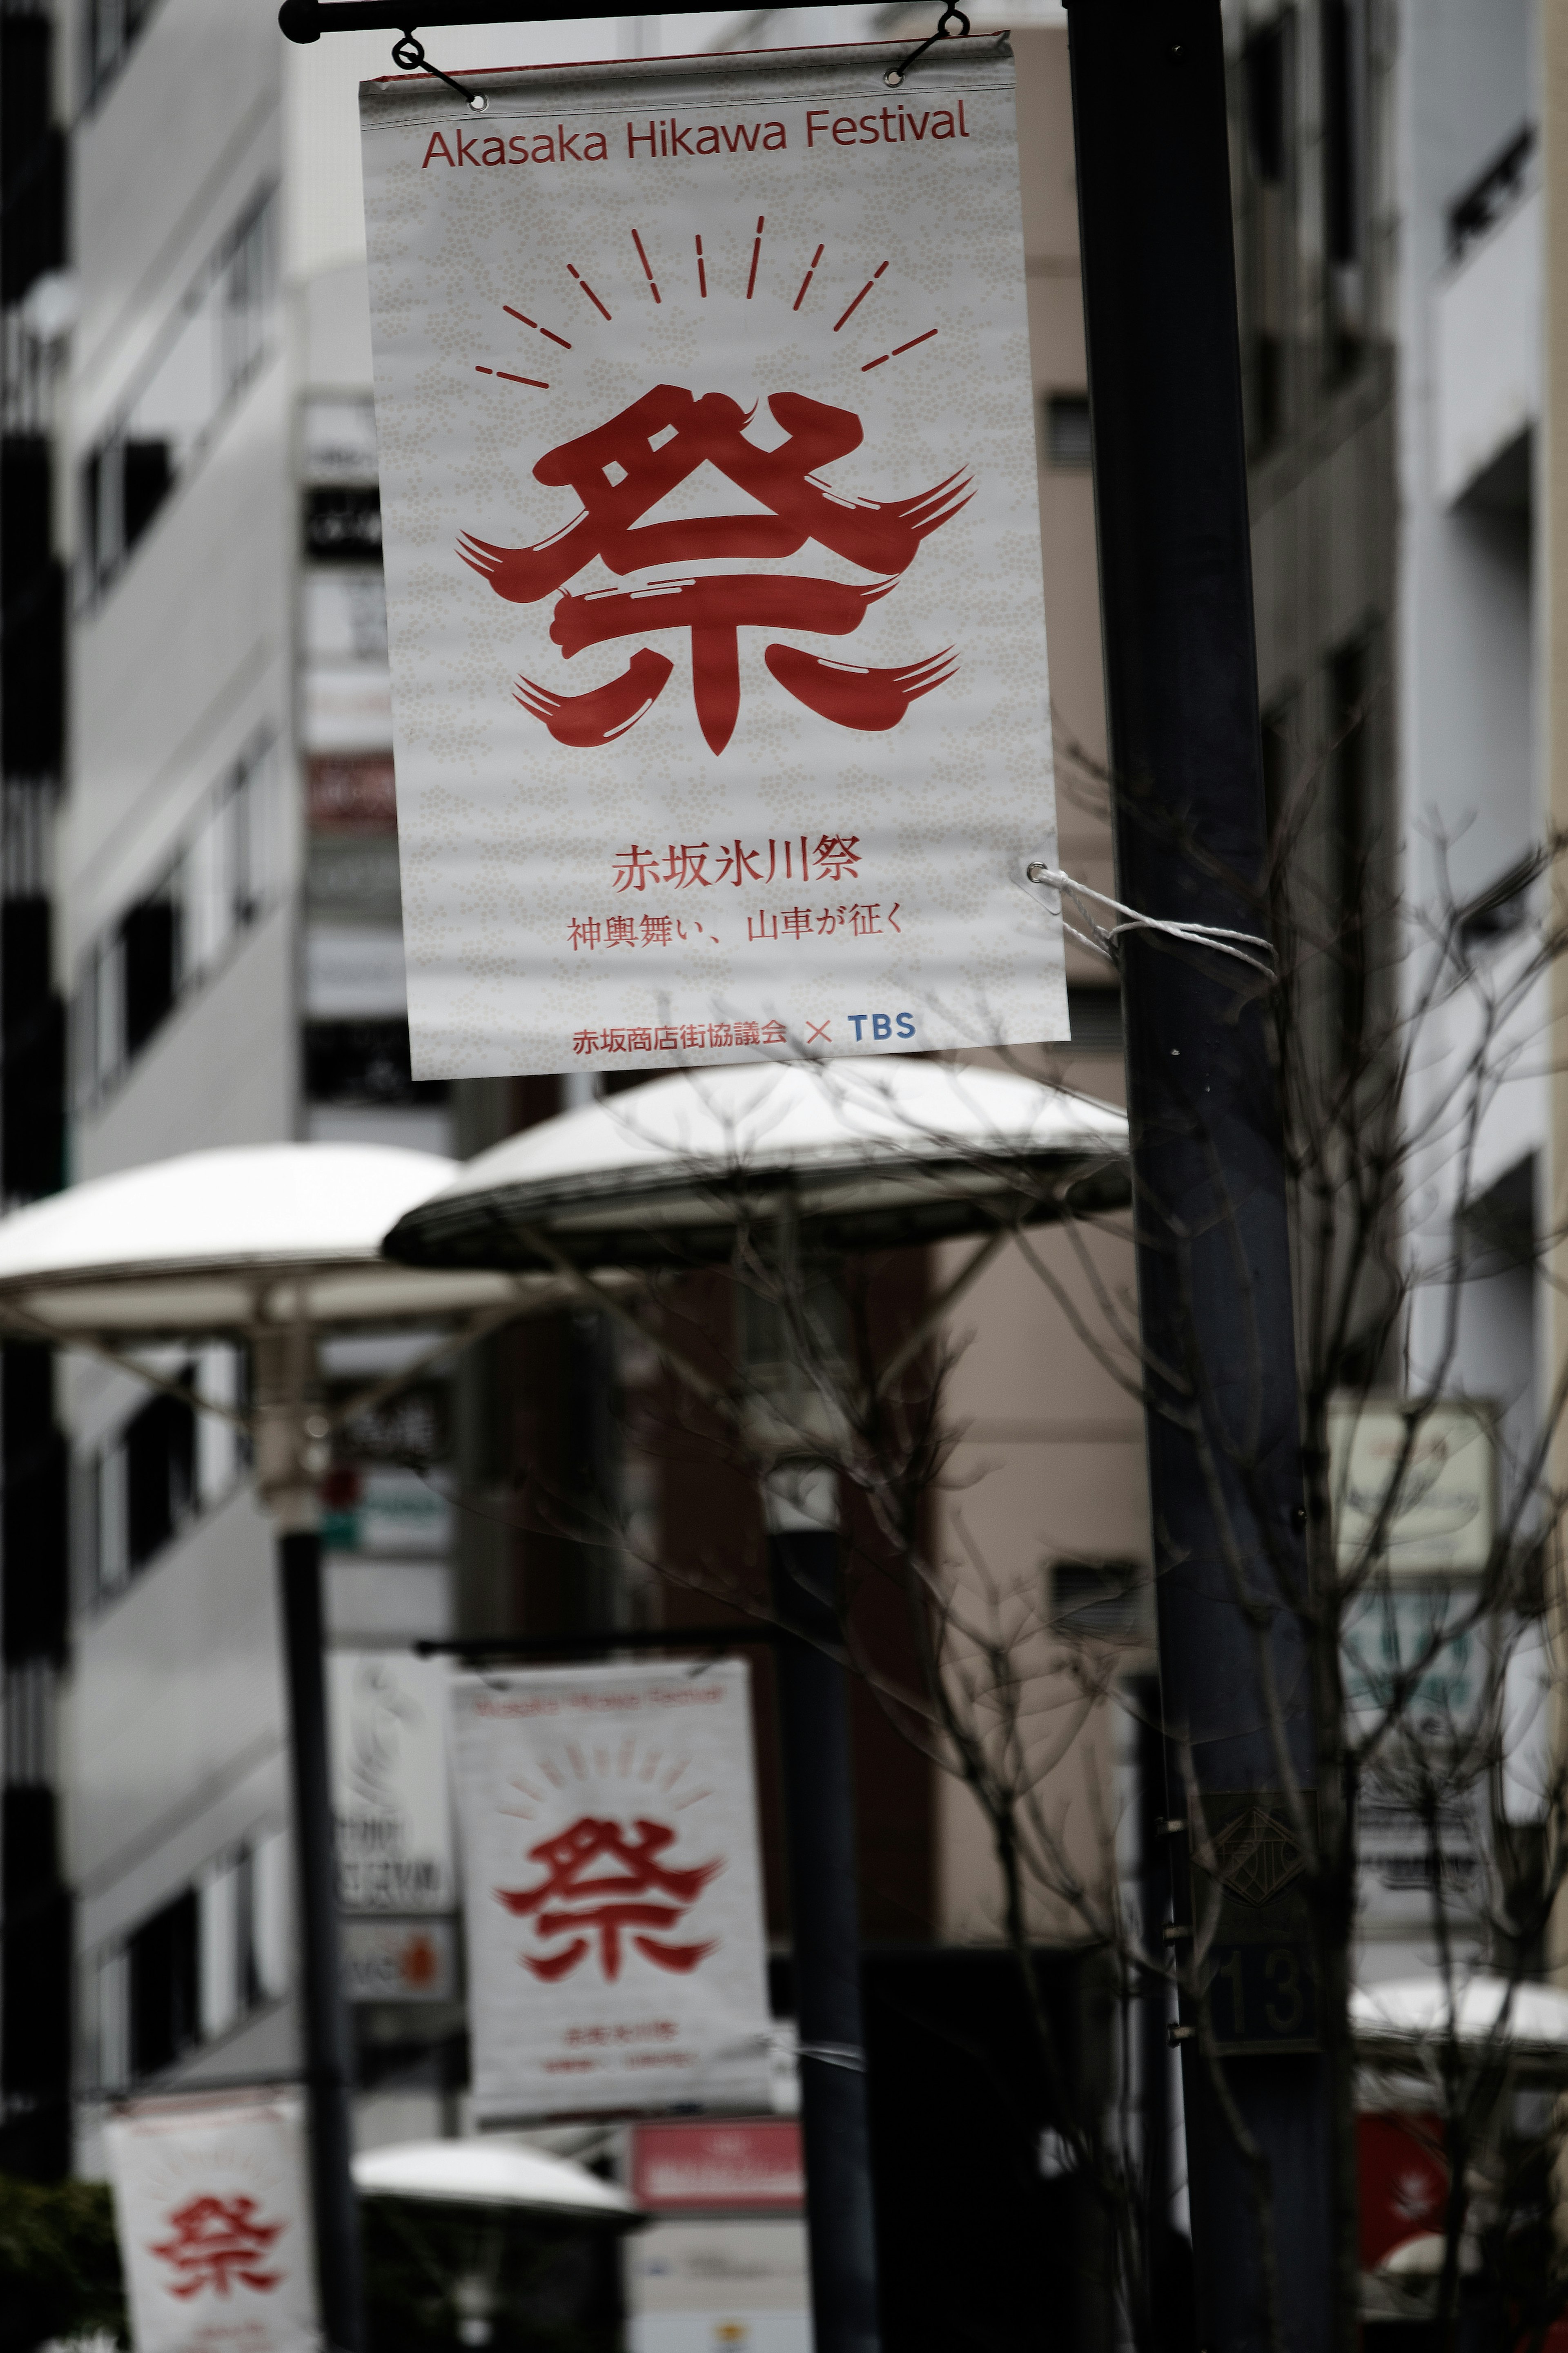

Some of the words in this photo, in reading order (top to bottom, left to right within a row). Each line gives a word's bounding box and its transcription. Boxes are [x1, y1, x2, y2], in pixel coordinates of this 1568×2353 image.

[422, 124, 608, 168] Akasaka
[627, 118, 787, 158] Hikawa
[806, 100, 969, 147] Festival
[454, 384, 978, 756] 祭
[612, 834, 862, 893] 赤坂氷川祭
[572, 1019, 787, 1055] 赤坂商店街協議会
[847, 1012, 916, 1042] TBS
[492, 1816, 728, 1983] 祭
[1219, 1948, 1304, 2034] 13
